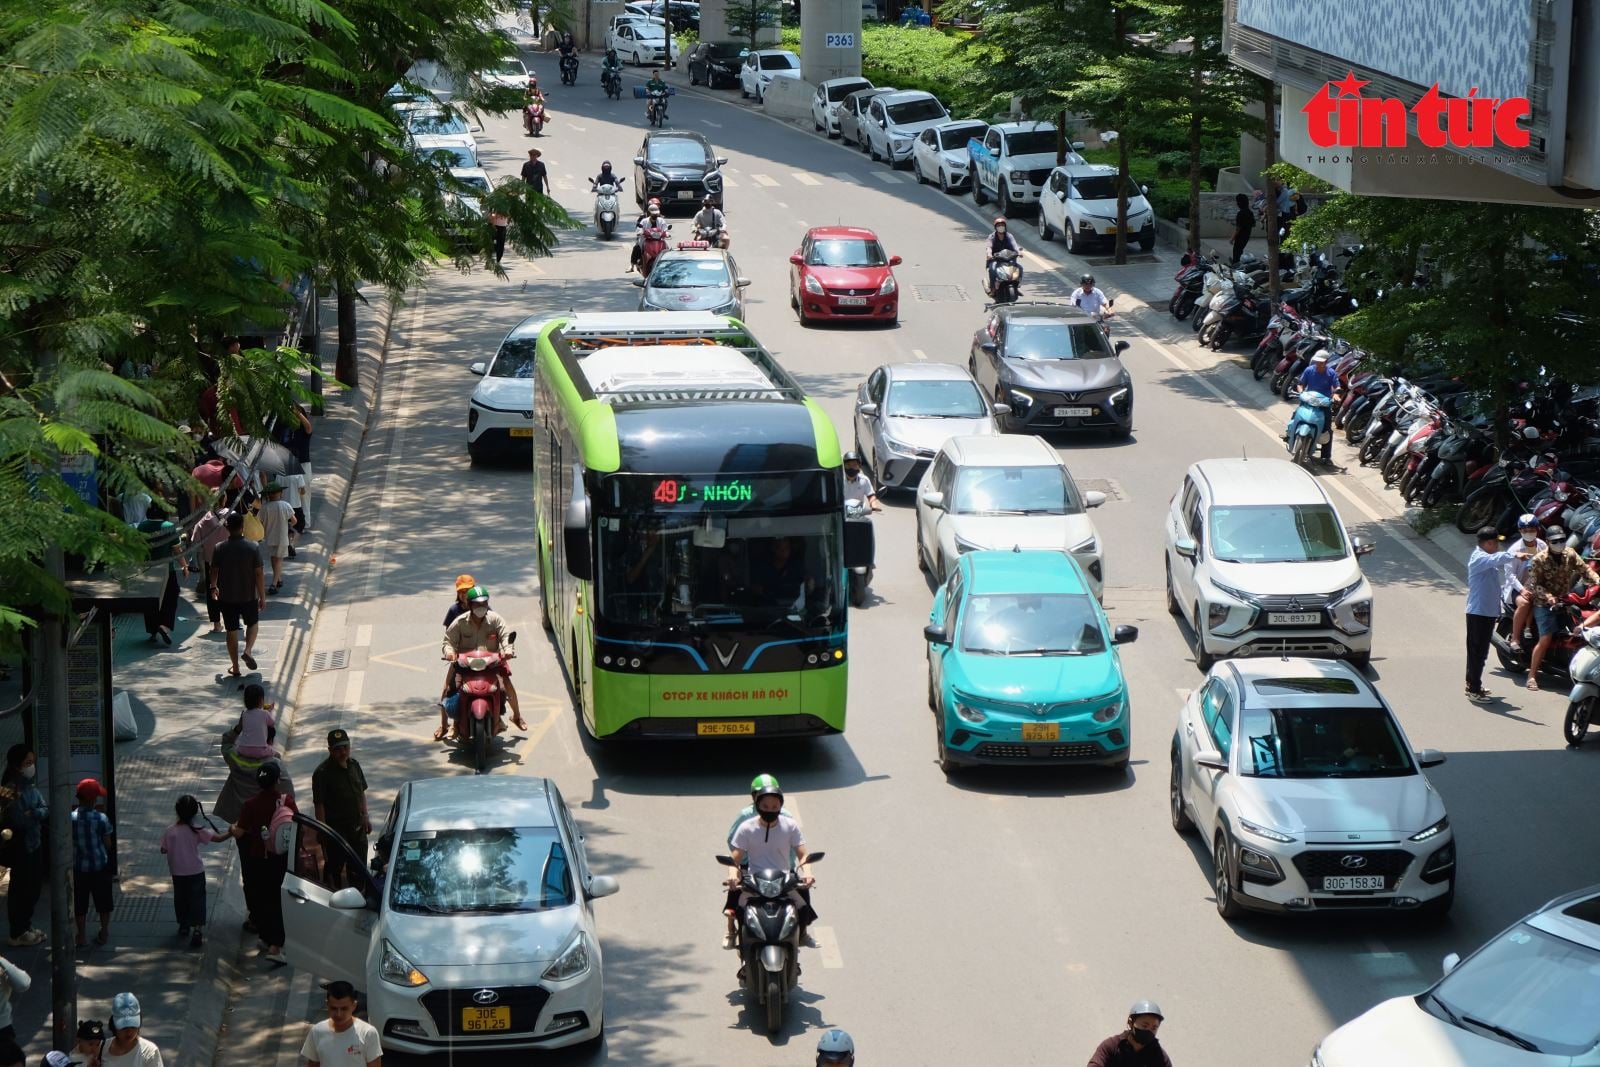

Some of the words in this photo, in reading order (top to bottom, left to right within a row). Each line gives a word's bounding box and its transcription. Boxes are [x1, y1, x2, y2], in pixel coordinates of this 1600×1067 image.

[827, 35, 853, 46] P363
[655, 480, 677, 502] 49
[662, 691, 693, 701] CTCP
[696, 691, 708, 701] XE
[711, 690, 749, 700] KHÁCH
[752, 687, 766, 699] HÀ
[1325, 877, 1383, 889] 30G-158.34
[476, 1008, 497, 1019] 30E
[467, 1019, 506, 1030] 961.25
